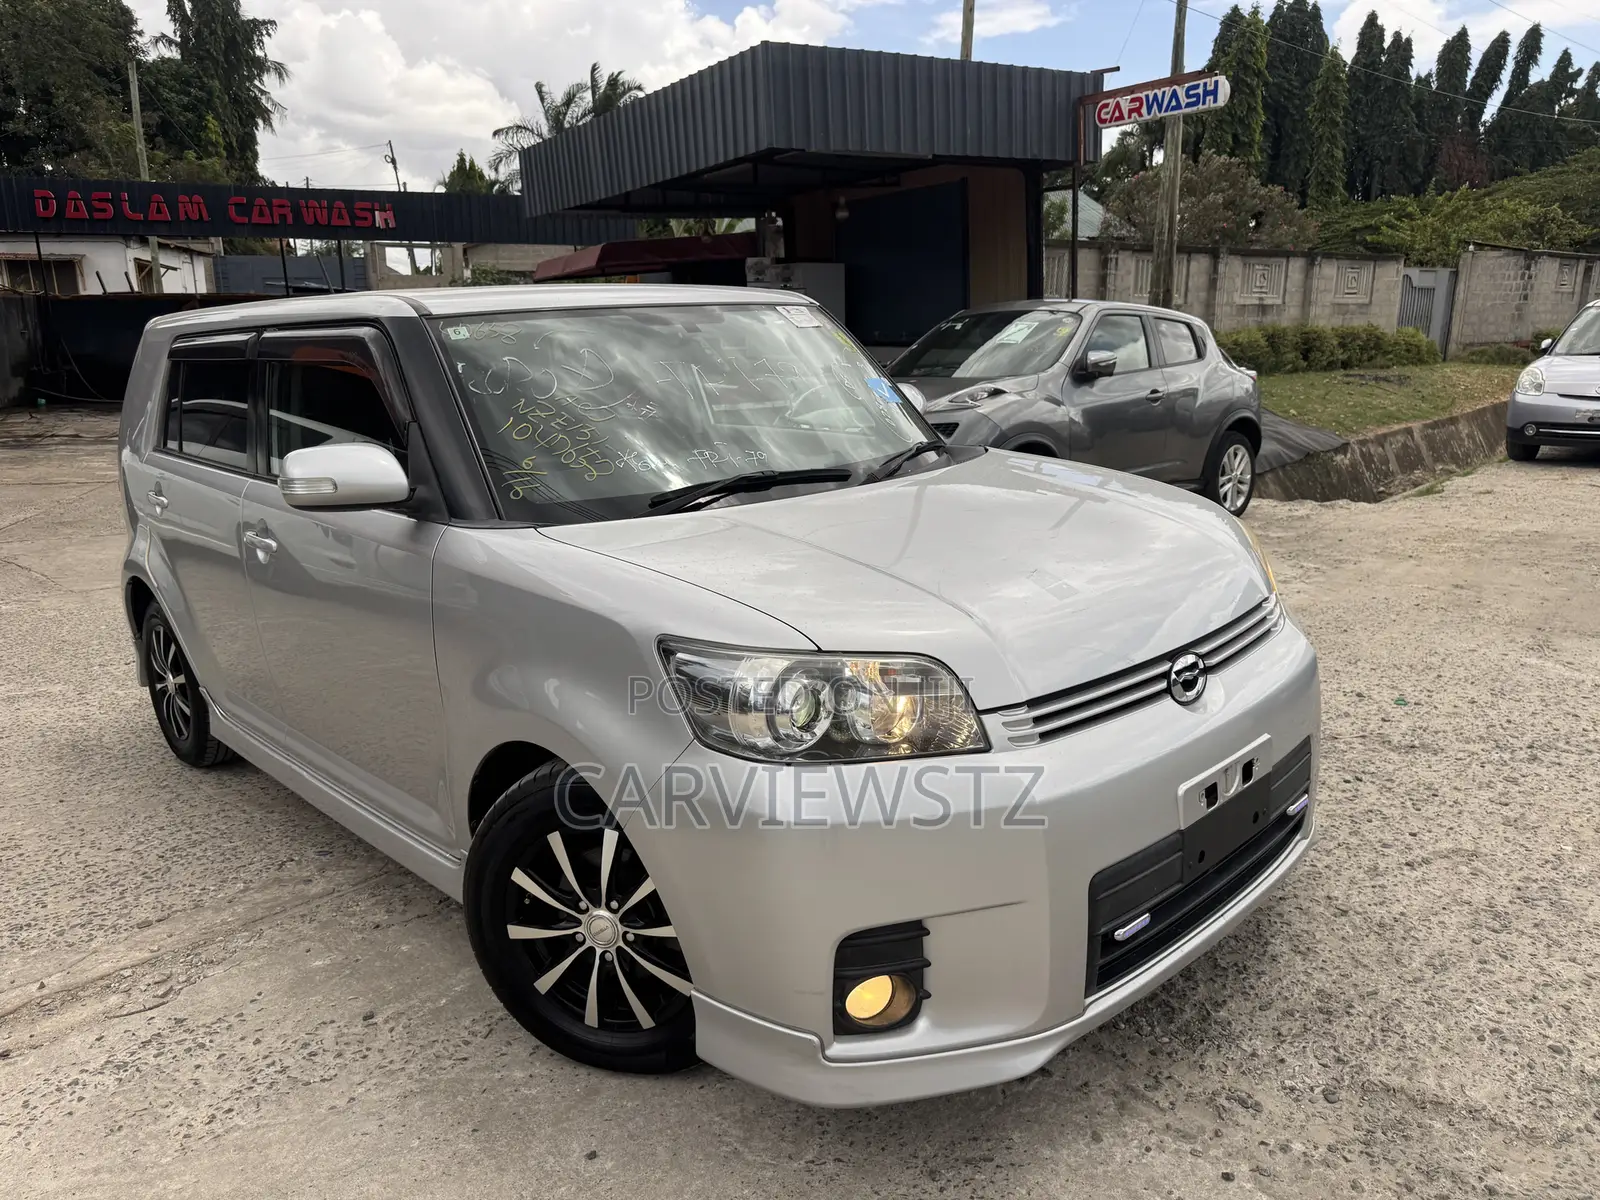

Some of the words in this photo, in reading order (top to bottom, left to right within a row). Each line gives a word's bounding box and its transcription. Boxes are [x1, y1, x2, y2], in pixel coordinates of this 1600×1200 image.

[33, 189, 211, 222] DASLAM
[228, 196, 293, 226] CAR
[300, 199, 397, 230] WASH
